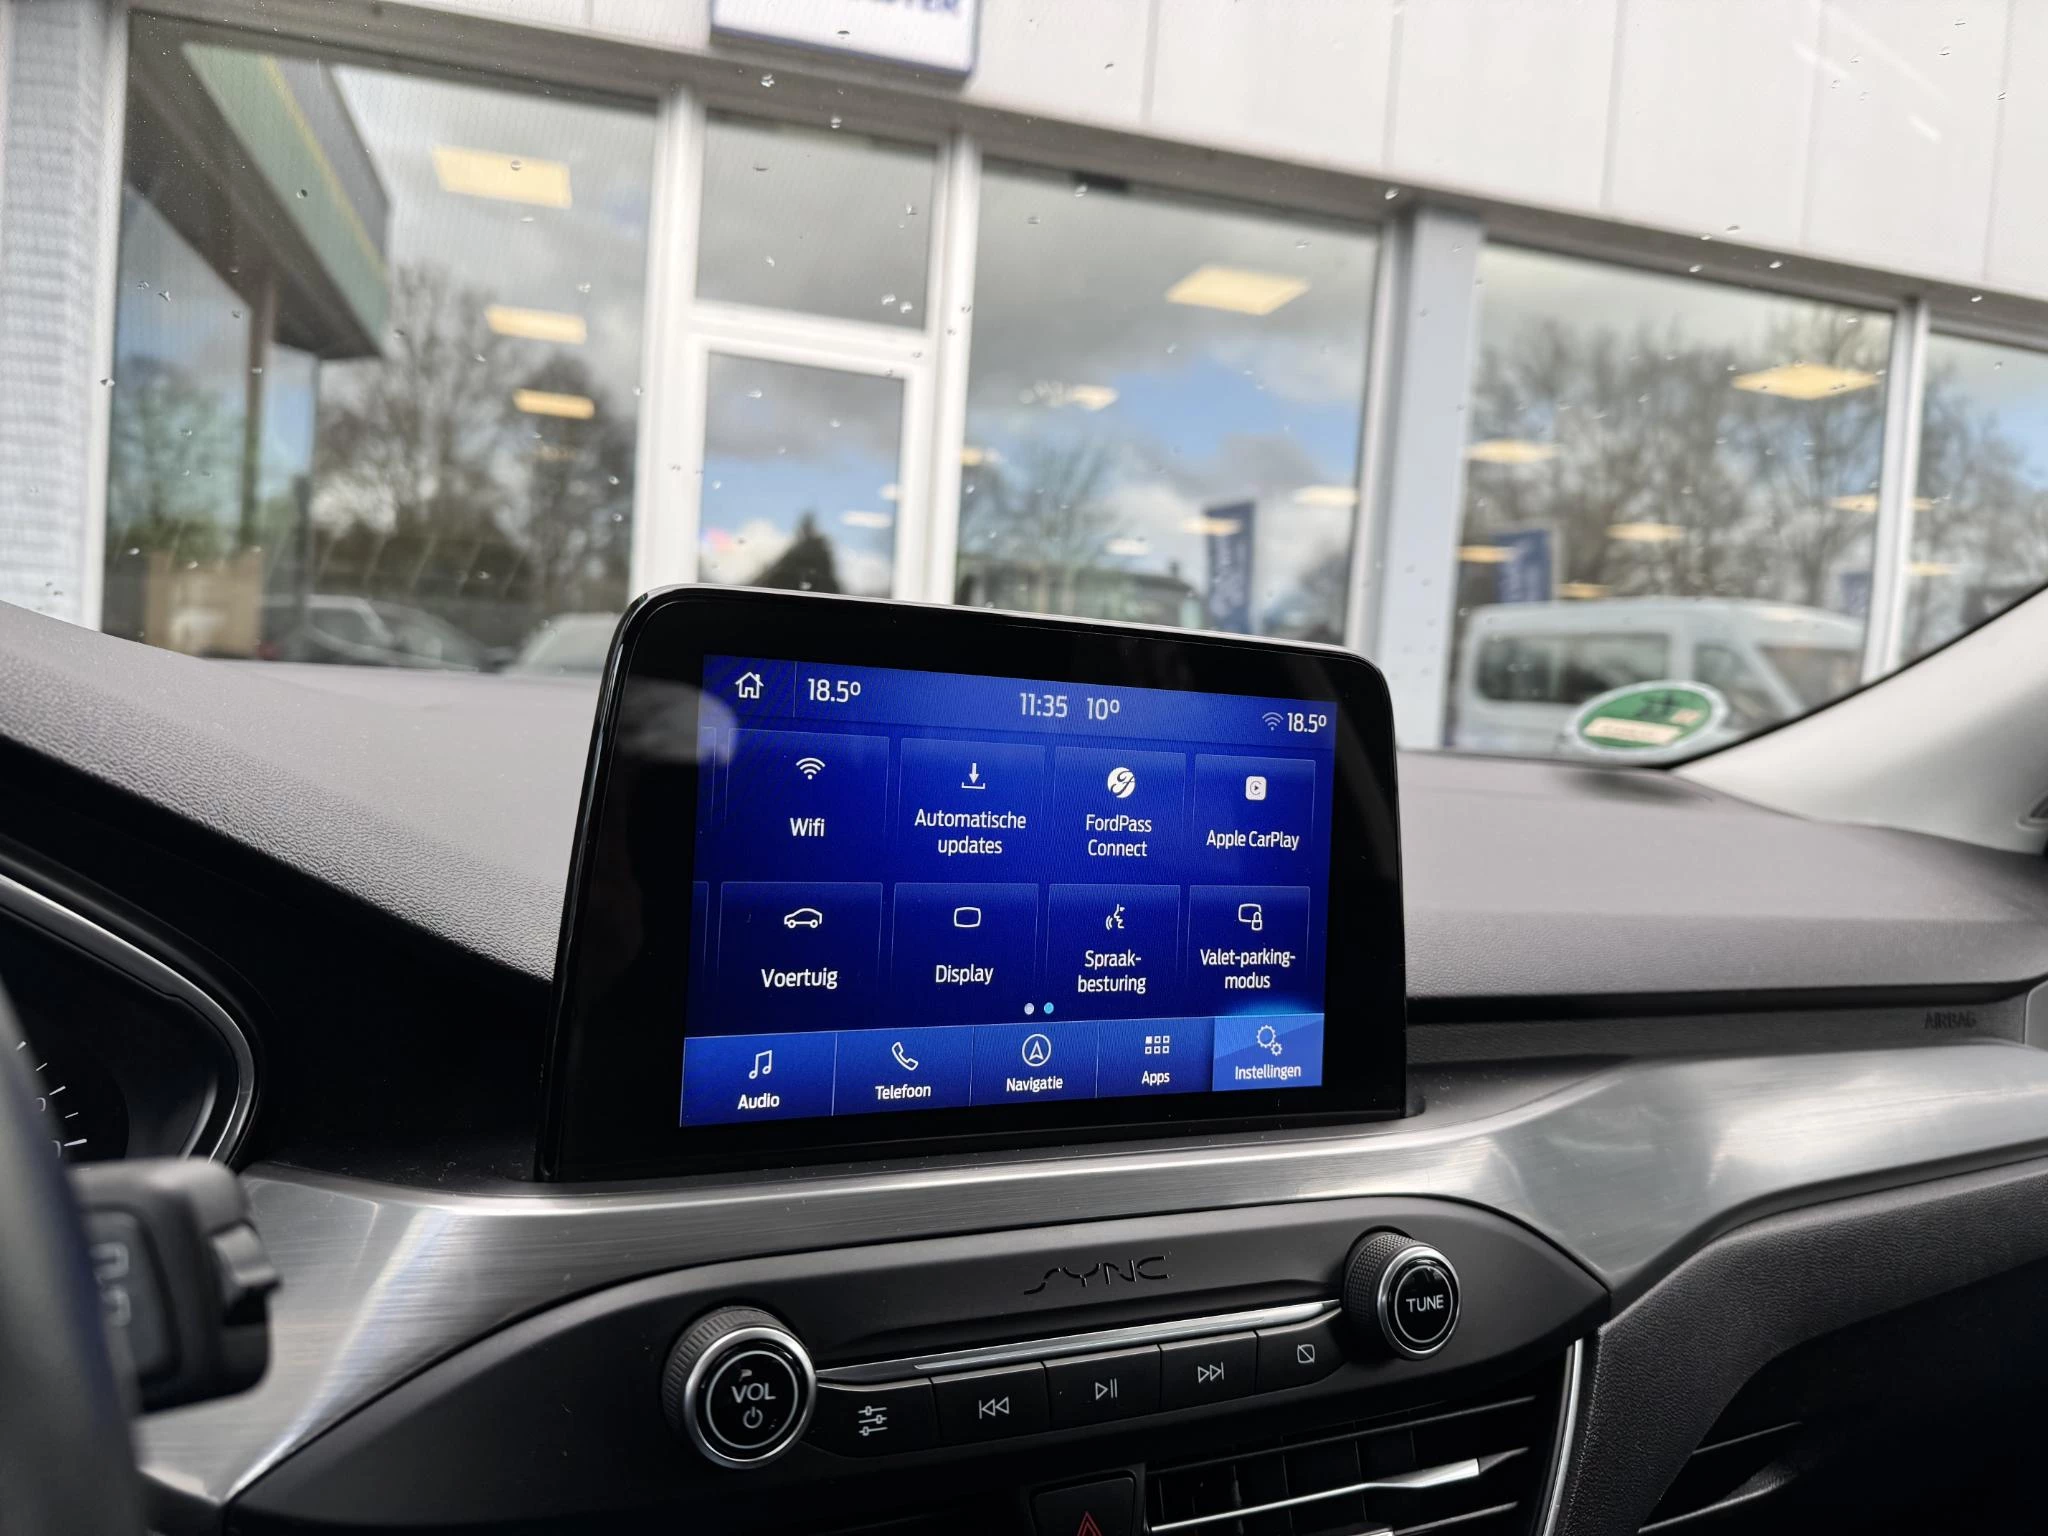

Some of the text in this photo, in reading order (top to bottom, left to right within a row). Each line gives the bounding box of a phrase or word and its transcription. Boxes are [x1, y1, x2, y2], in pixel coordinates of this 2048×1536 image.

[1018, 691, 1069, 719] 11:35
[789, 817, 826, 838] Wifi
[914, 807, 1028, 830] Automatische
[1085, 813, 1153, 833] FordPass
[936, 835, 1004, 856] updates
[1087, 838, 1148, 858] Connect
[1206, 829, 1300, 852] Apple CarPlay
[1084, 949, 1142, 972] Spraak-
[1199, 947, 1296, 972] Valet-parking-
[760, 967, 838, 991] Voertuig
[934, 963, 995, 987] Display
[1077, 972, 1147, 996] besturing
[1224, 972, 1271, 990] modus
[1923, 1010, 1977, 1030] AIRBAG
[1141, 1070, 1171, 1088] Apps
[1234, 1063, 1303, 1083] Instellingen
[874, 1083, 932, 1101] Telefoon
[1006, 1075, 1065, 1095] Navigatie
[737, 1092, 780, 1111] Audio
[1023, 1255, 1170, 1296] SYNC
[1405, 1294, 1444, 1313] TUNE
[731, 1382, 777, 1404] VOL
